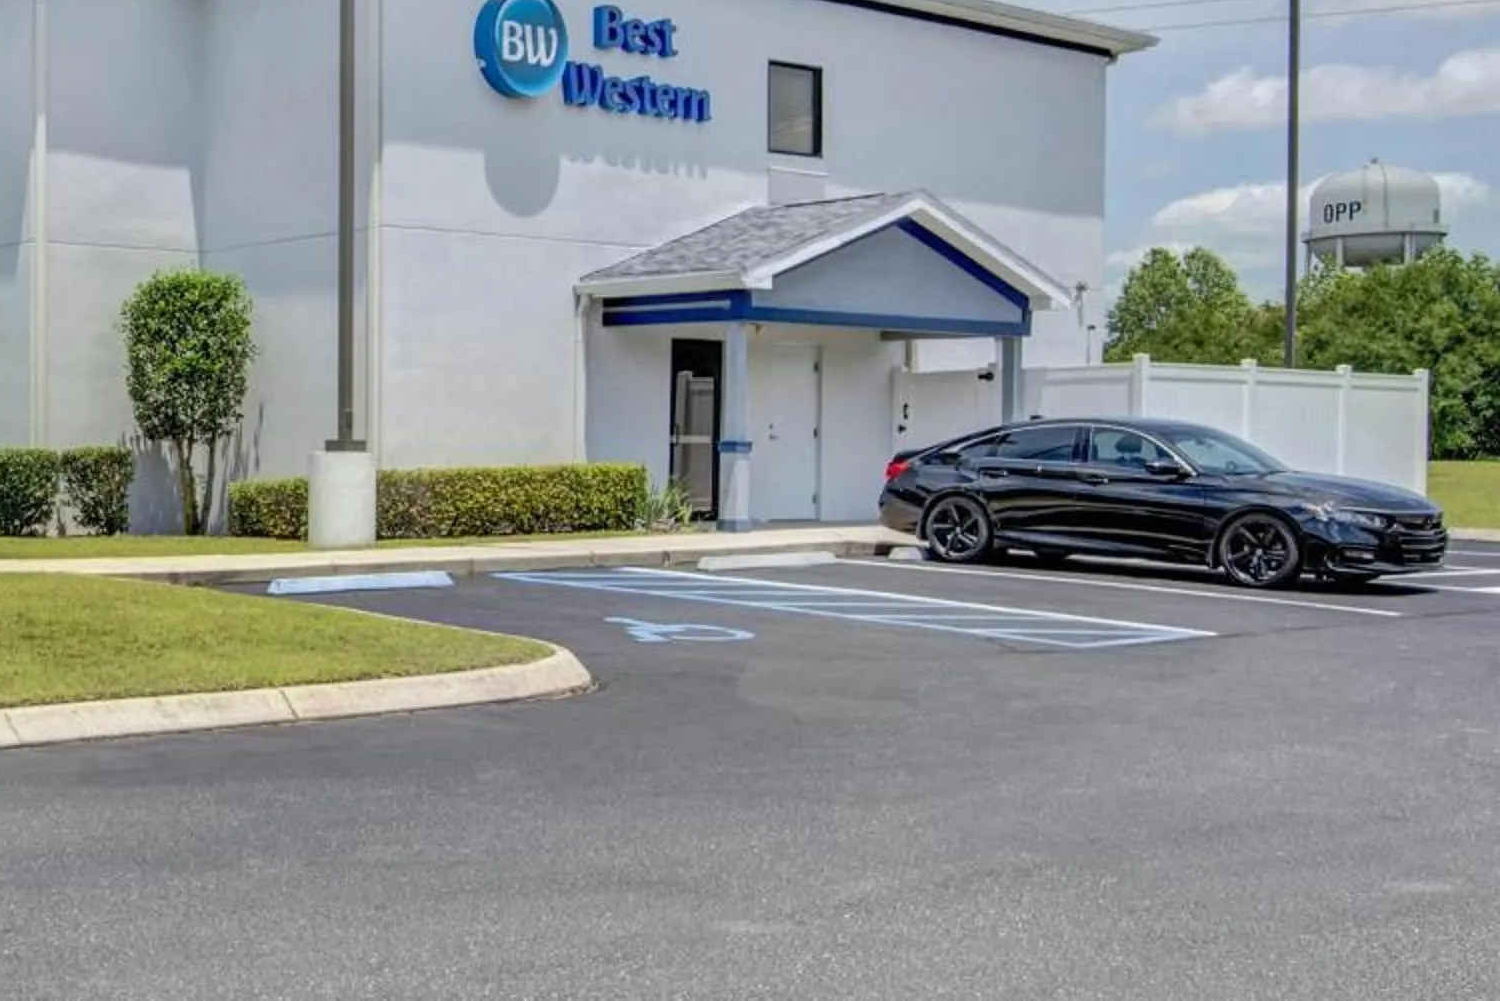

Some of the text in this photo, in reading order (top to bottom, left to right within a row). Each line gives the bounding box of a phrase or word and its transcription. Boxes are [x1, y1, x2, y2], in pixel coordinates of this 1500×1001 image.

[502, 20, 558, 67] BW
[593, 5, 678, 58] Best
[562, 60, 712, 122] Western
[1323, 200, 1362, 224] OPP
